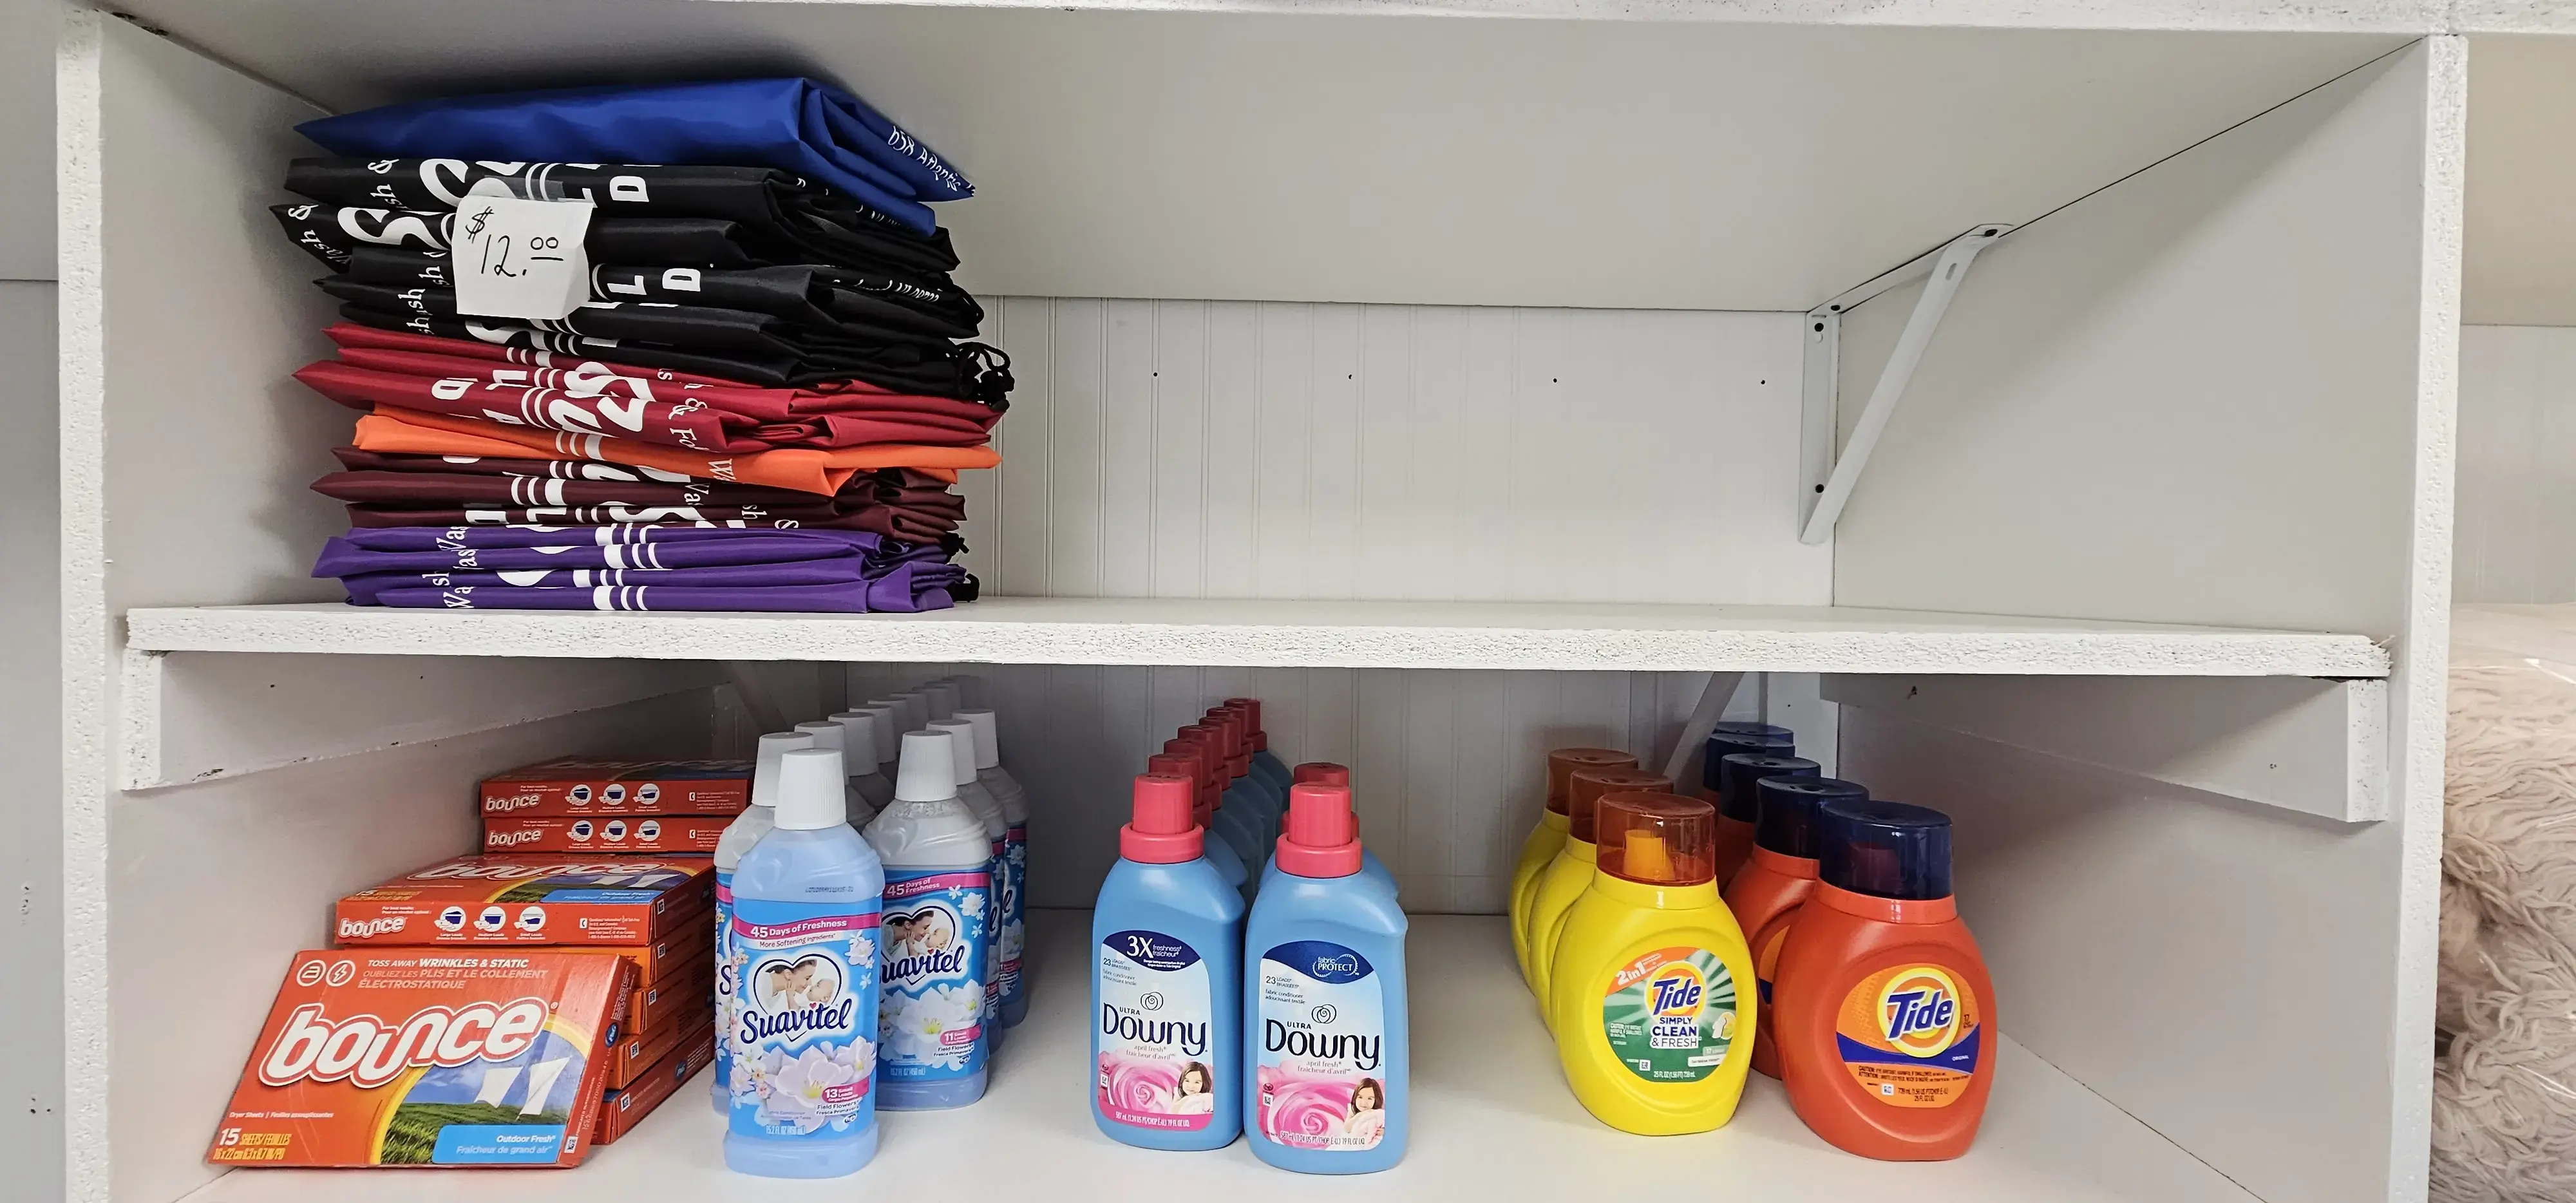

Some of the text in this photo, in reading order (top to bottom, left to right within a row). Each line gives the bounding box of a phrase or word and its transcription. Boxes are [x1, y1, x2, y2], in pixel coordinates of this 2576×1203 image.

[485, 793, 541, 812] bounce
[488, 829, 544, 847] bounce
[887, 885, 905, 896] 45
[923, 877, 931, 886] of
[905, 882, 940, 895] Freshness
[338, 916, 406, 939] bounce
[750, 920, 848, 938] 45 Days of Freshness
[759, 940, 776, 949] More
[776, 936, 806, 948] Softening
[1126, 935, 1154, 958] 3X
[419, 958, 478, 968] WRINKLES
[480, 959, 488, 967] &
[489, 959, 529, 968] STATIC
[880, 945, 965, 985] uavitel
[1103, 958, 1112, 967] 23
[1318, 963, 1354, 972] PROTECT
[419, 969, 444, 978] PLIS
[447, 969, 462, 978] ET
[463, 969, 478, 978] LE
[480, 970, 549, 979] COLLEMENT
[1265, 975, 1276, 985] 23
[357, 979, 467, 989] ÉLECTROSTATIQUE
[1278, 990, 1303, 999] conditioner
[1653, 978, 1702, 1016] Tide
[1119, 1006, 1141, 1016] ULTRA
[1887, 990, 1954, 1039] Tide
[740, 998, 854, 1045] Suavitel
[1286, 1021, 1312, 1030] ULTRA
[1659, 1016, 1693, 1025] SIMPLY
[1103, 1002, 1207, 1056] Downy
[1652, 1026, 1698, 1037] CLEAN
[260, 998, 547, 1088] bounce
[1265, 1018, 1380, 1070] Downy
[1651, 1037, 1698, 1048] & FRESH
[825, 1088, 838, 1099] 13
[218, 1128, 242, 1146] 15
[497, 1135, 529, 1143] Outdoor
[509, 1145, 535, 1155] grand
